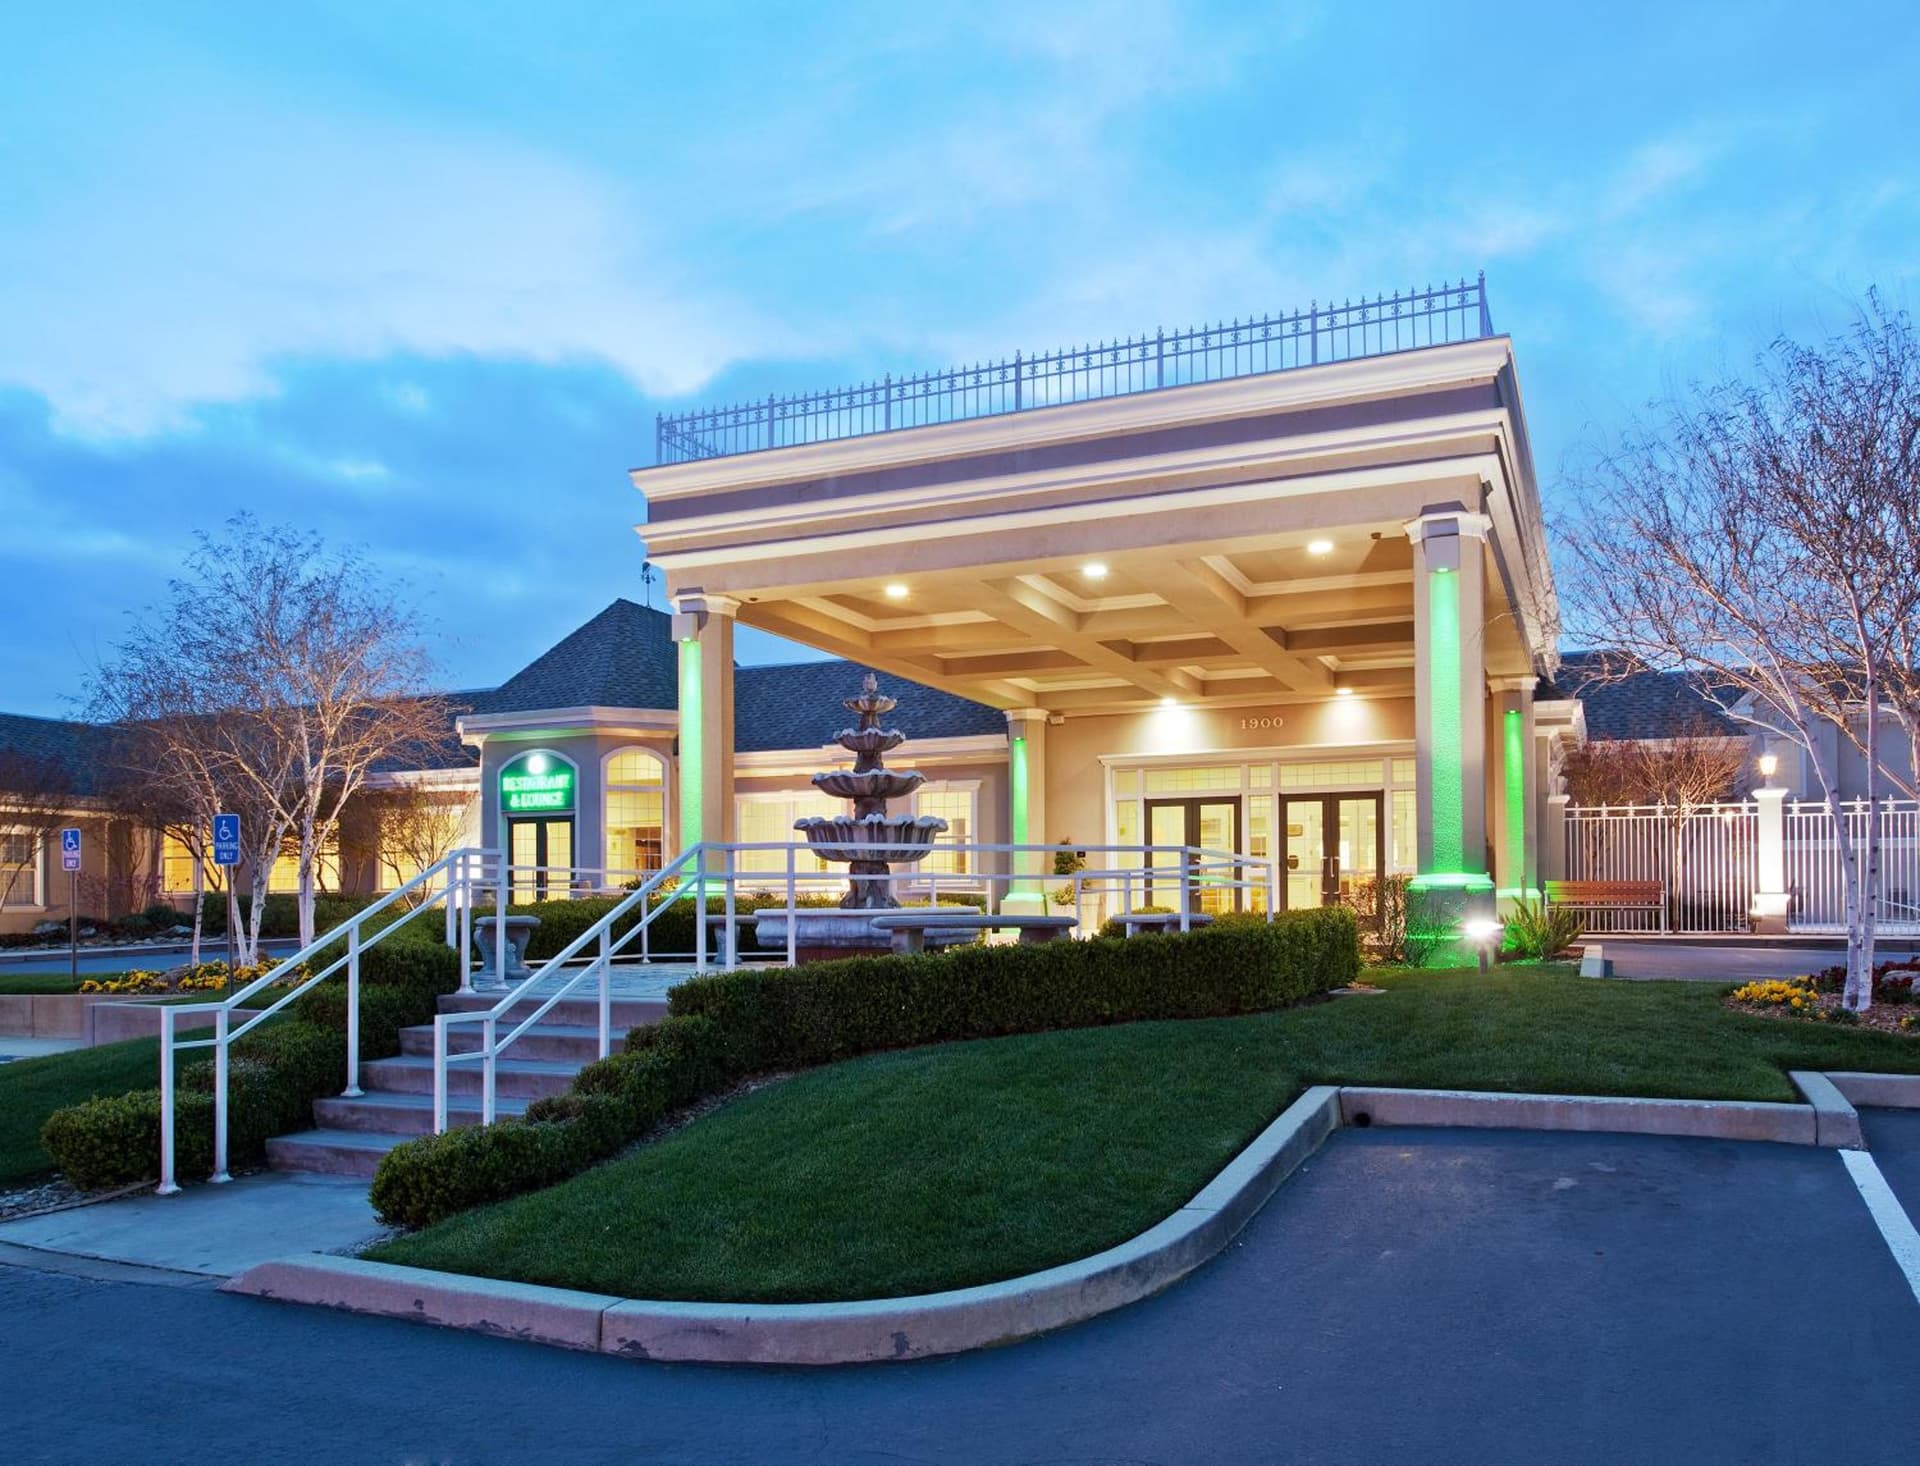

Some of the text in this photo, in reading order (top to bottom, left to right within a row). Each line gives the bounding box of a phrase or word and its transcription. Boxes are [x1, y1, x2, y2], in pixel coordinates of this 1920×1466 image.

[1241, 716, 1284, 729] 1900
[502, 774, 570, 791] RESTAURANT
[510, 791, 565, 807] & LOUNGE
